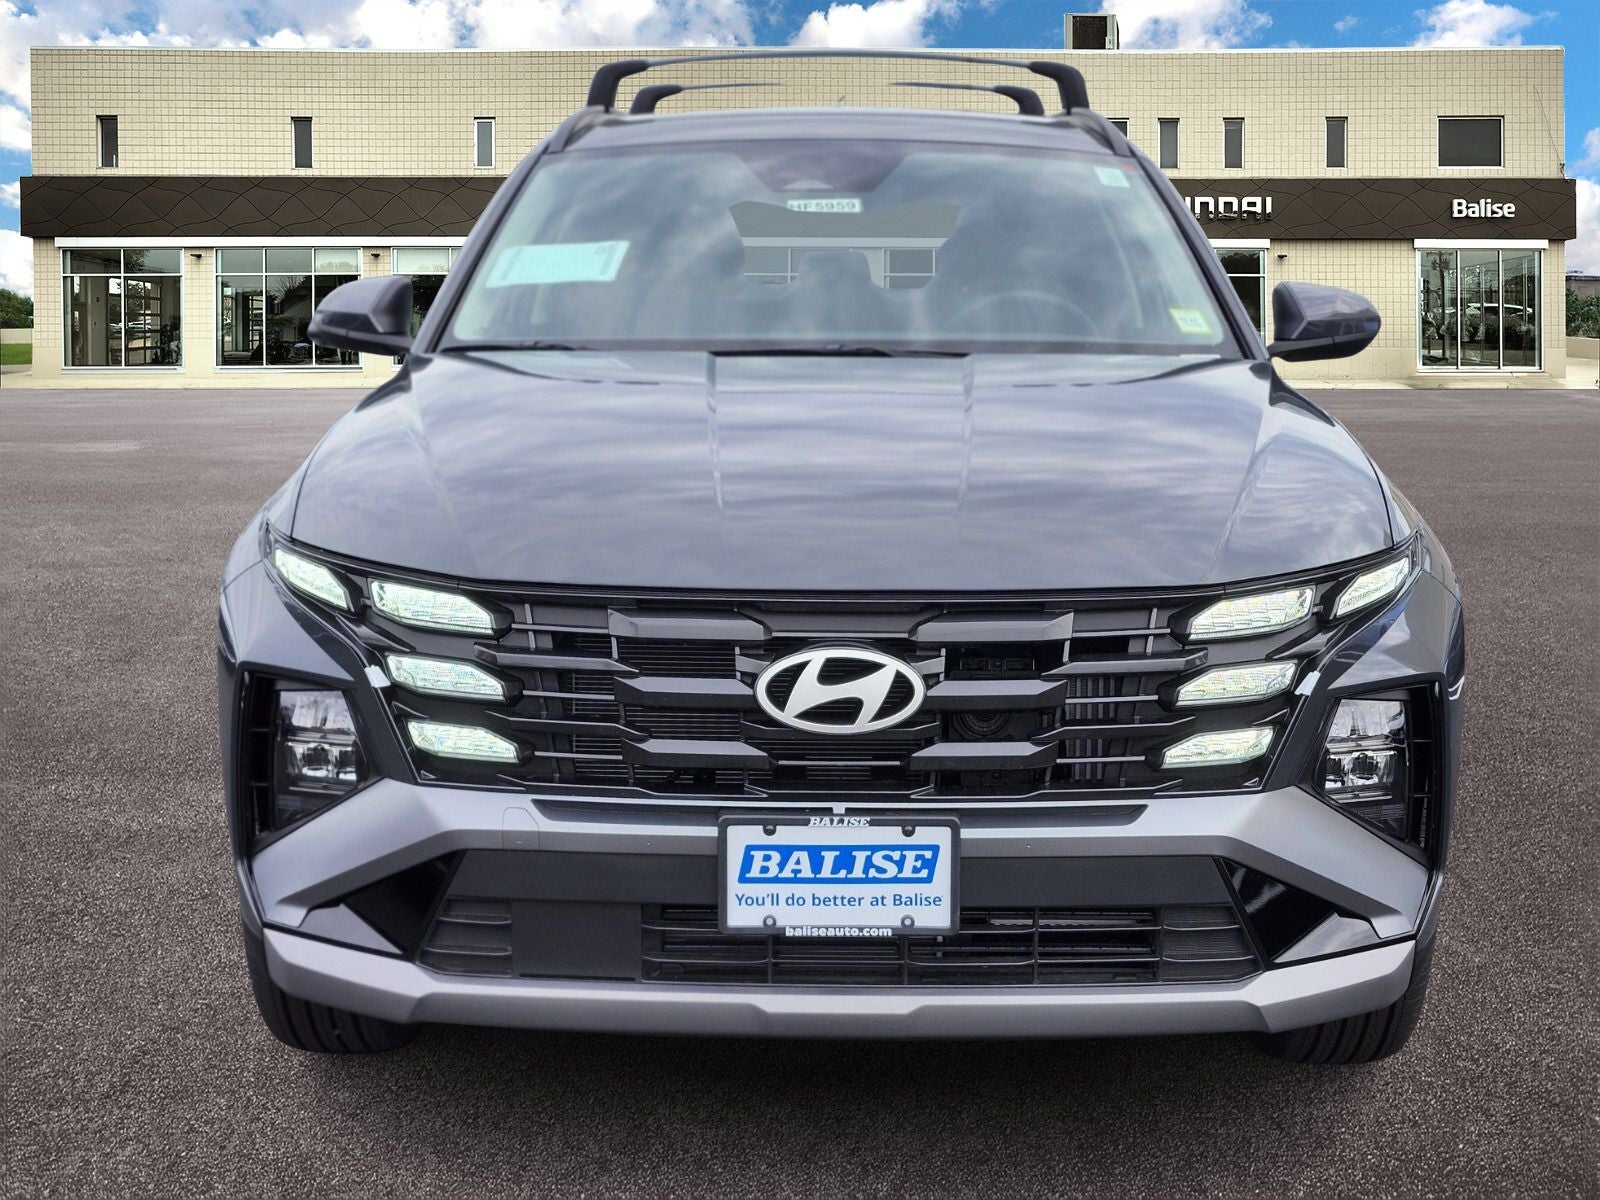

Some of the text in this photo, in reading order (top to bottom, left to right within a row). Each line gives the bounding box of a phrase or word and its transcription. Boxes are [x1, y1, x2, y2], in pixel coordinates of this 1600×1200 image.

[1184, 196, 1273, 219] NDAI
[1452, 198, 1516, 218] Balise
[808, 816, 871, 828] BALISE
[745, 850, 933, 879] BALISE
[785, 893, 806, 907] do
[811, 893, 865, 907] better
[869, 894, 887, 907] at
[892, 893, 943, 907] Balise
[785, 926, 893, 937] baliseauto.com
